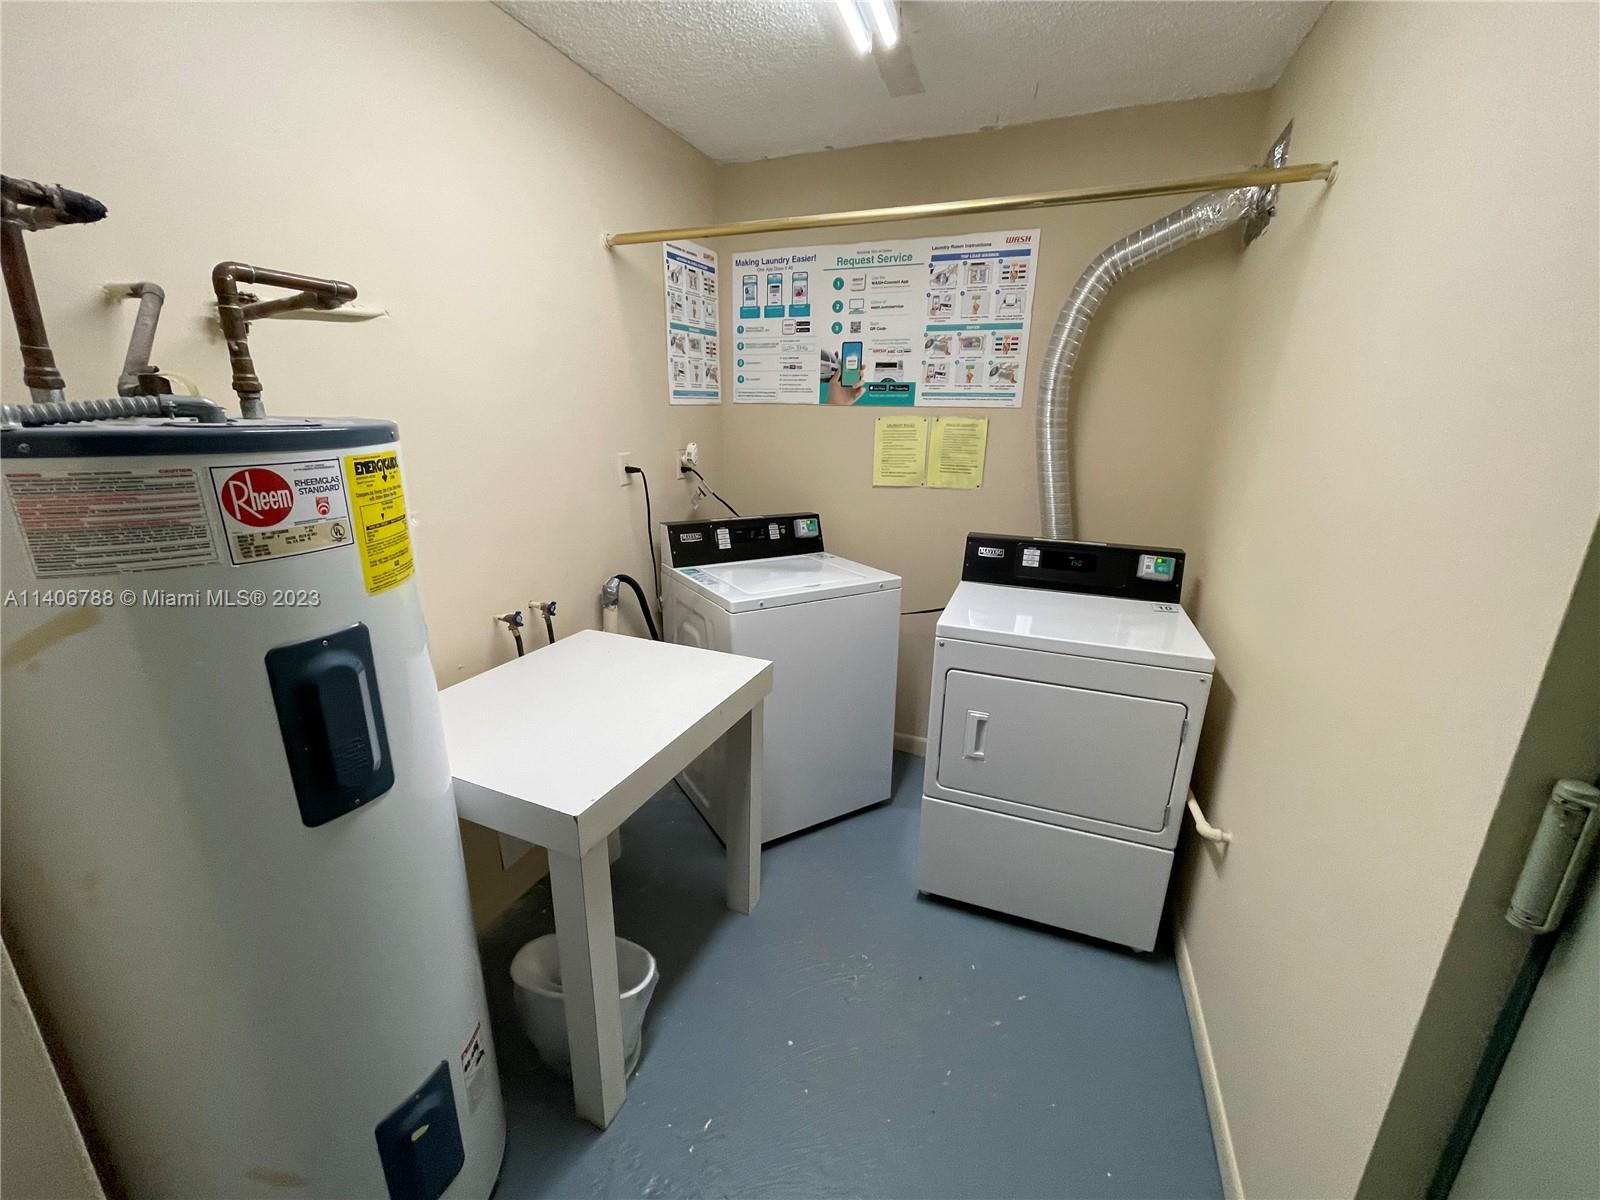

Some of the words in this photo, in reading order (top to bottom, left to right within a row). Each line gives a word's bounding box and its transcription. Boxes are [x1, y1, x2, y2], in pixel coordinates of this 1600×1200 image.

[1006, 236, 1032, 244] WASH
[735, 258, 759, 267] Making
[761, 257, 790, 265] Laundry
[792, 254, 817, 263] Easier!
[836, 255, 874, 267] Request
[877, 252, 913, 263] Service
[228, 470, 293, 520] Rheem
[298, 484, 340, 495] STANDARD
